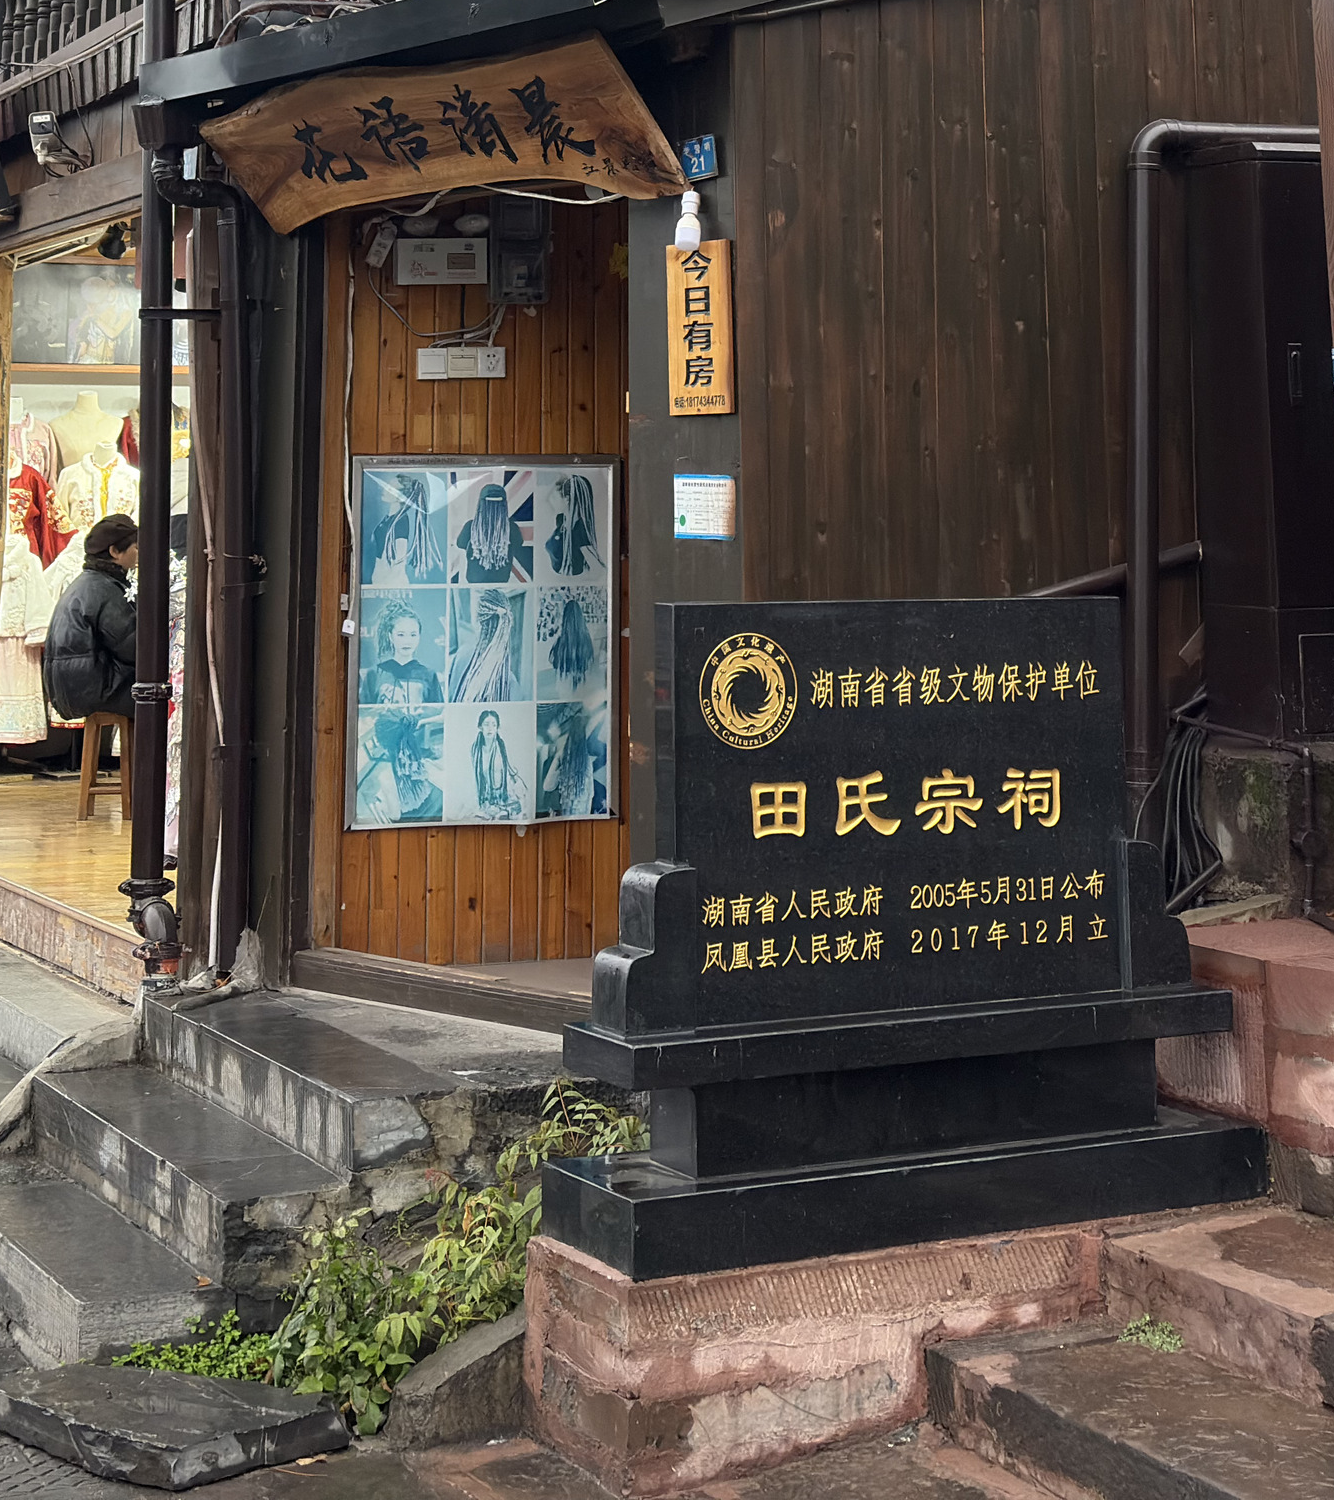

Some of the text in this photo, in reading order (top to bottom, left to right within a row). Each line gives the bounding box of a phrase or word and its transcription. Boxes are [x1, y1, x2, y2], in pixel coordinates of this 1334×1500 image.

[690, 155, 705, 173] 21
[681, 250, 715, 388] 今日有房
[710, 636, 786, 667] 中国文化遗产
[810, 660, 1101, 710] 湖南省省级文物保护单位
[702, 695, 794, 746] China Cultural Heritage
[750, 768, 1062, 839] 田氏宗祠
[701, 869, 1105, 927] 湖南省人民政府 2005年5月31日公布
[700, 930, 885, 974] 凤凰县人民政府
